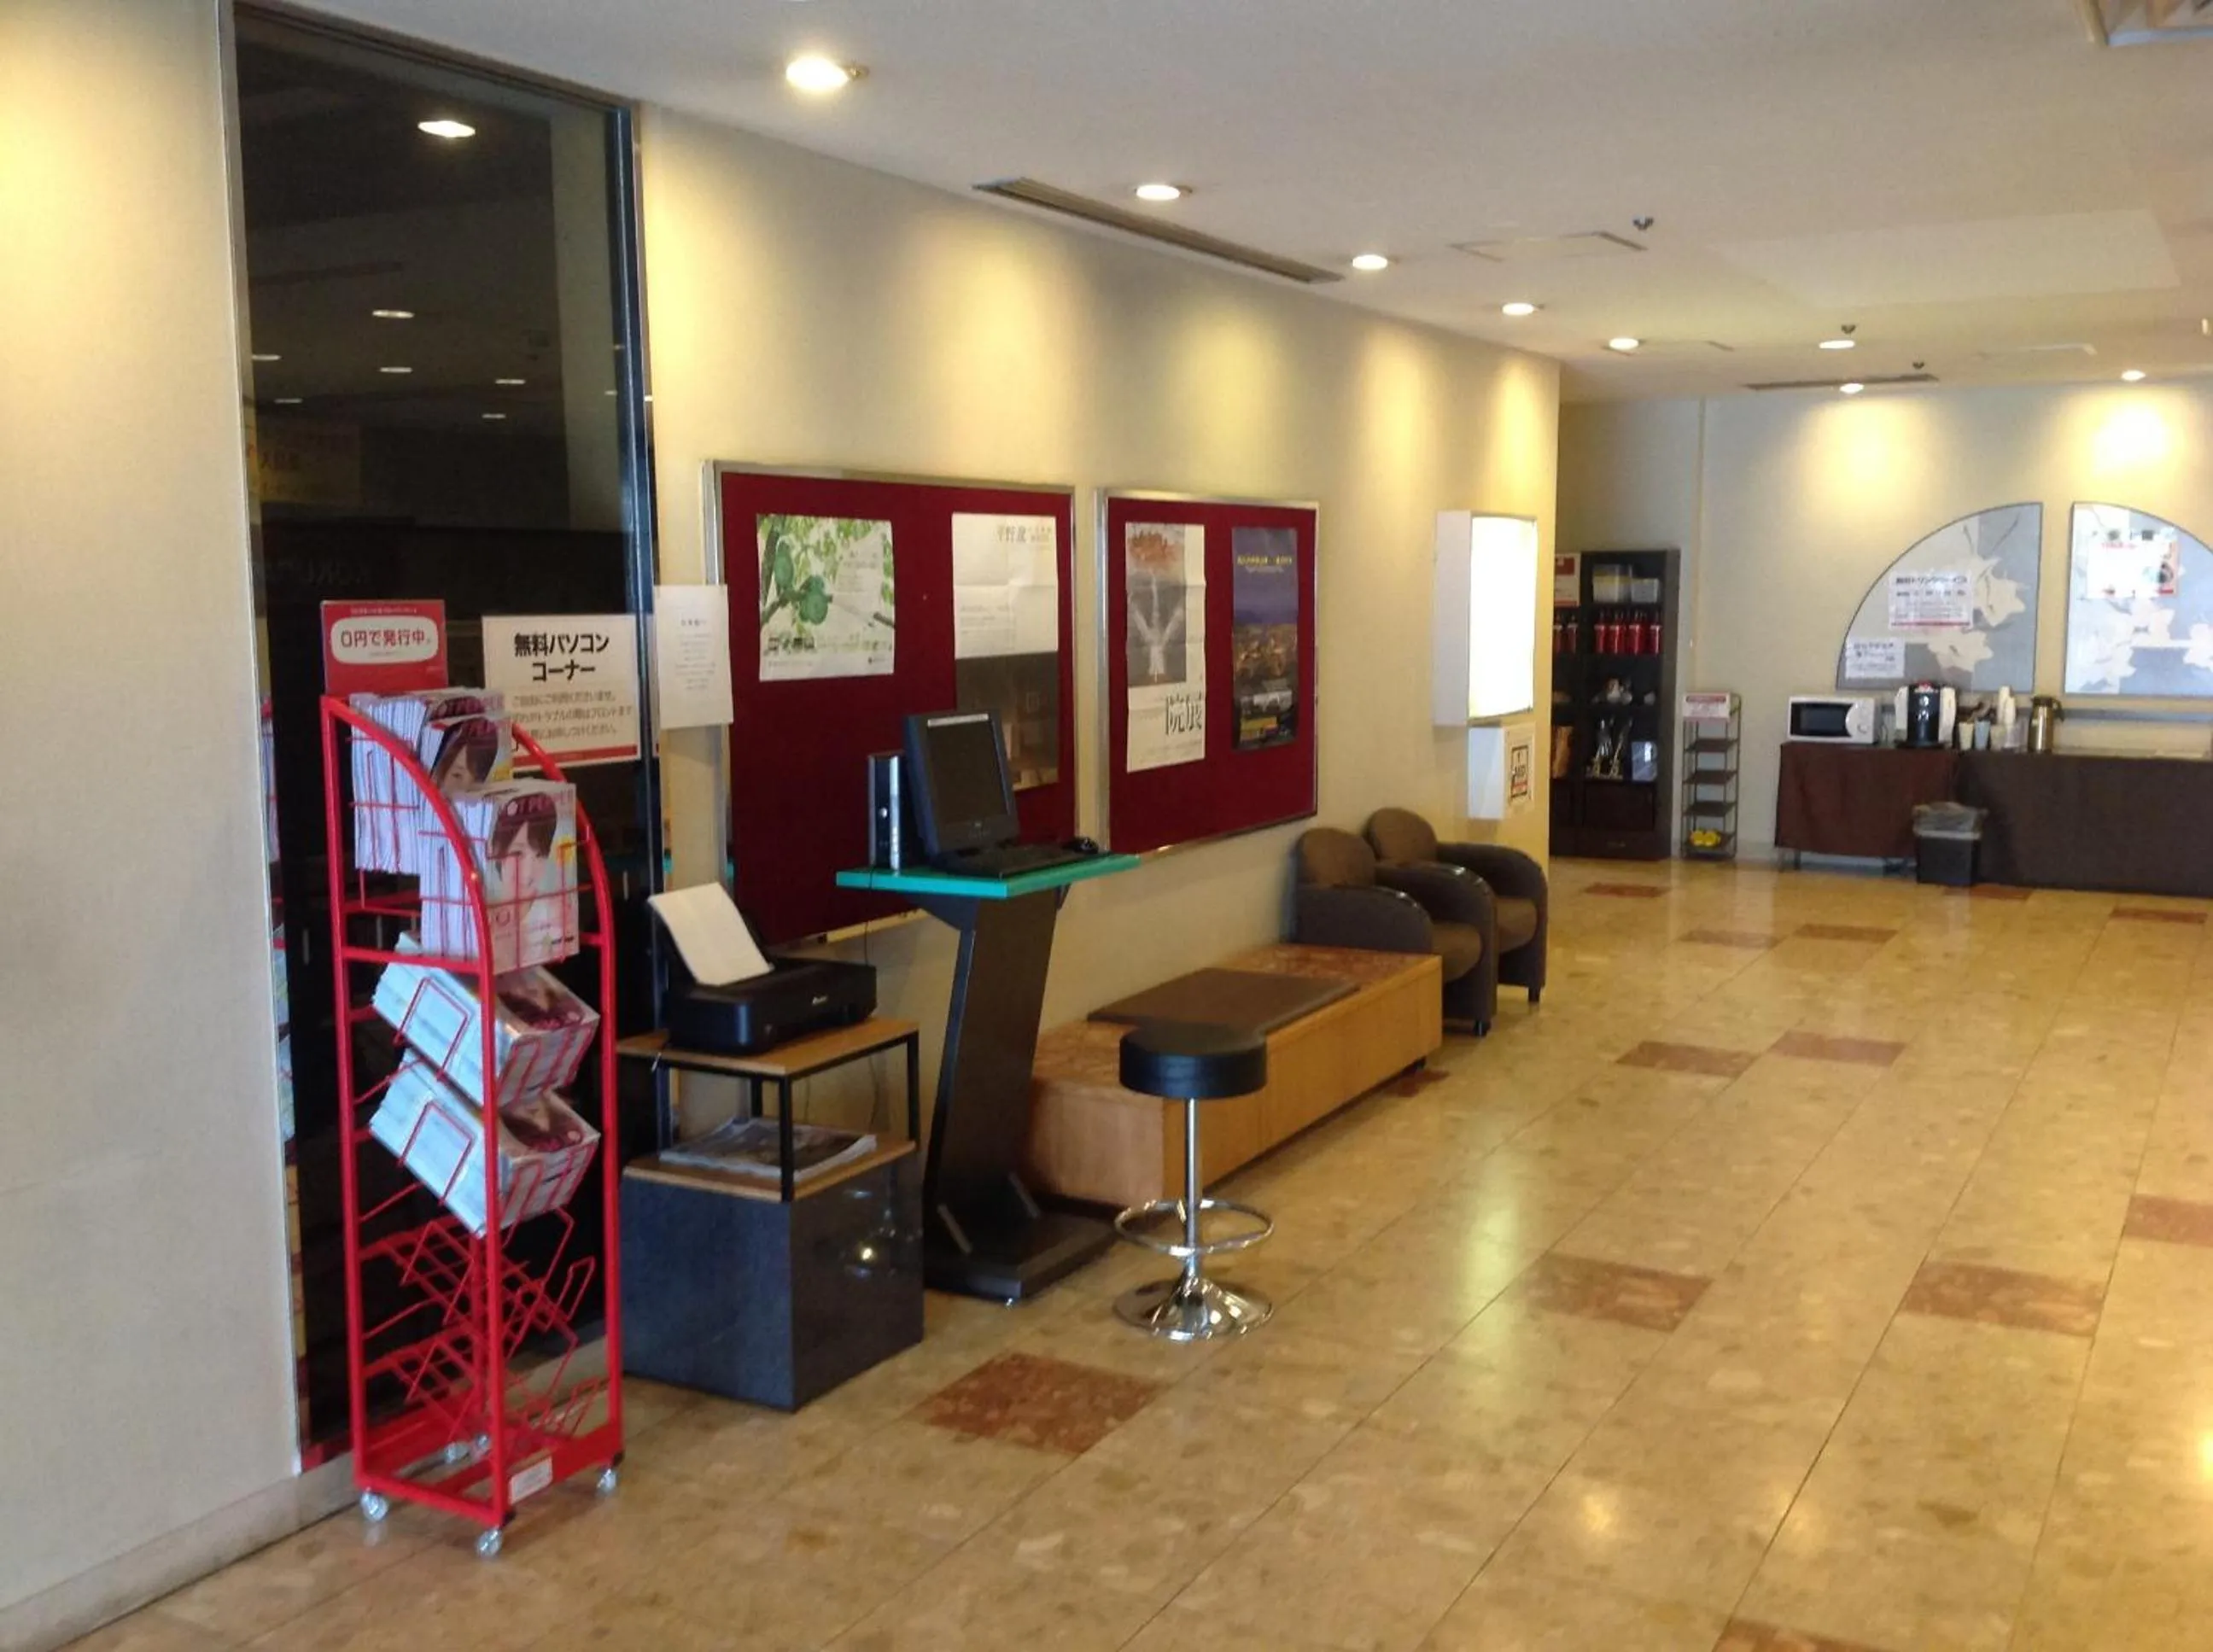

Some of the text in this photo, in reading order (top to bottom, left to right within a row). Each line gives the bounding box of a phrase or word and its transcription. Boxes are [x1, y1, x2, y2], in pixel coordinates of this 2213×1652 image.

[514, 633, 610, 657] 無料パソコン
[532, 658, 596, 682] コーナー
